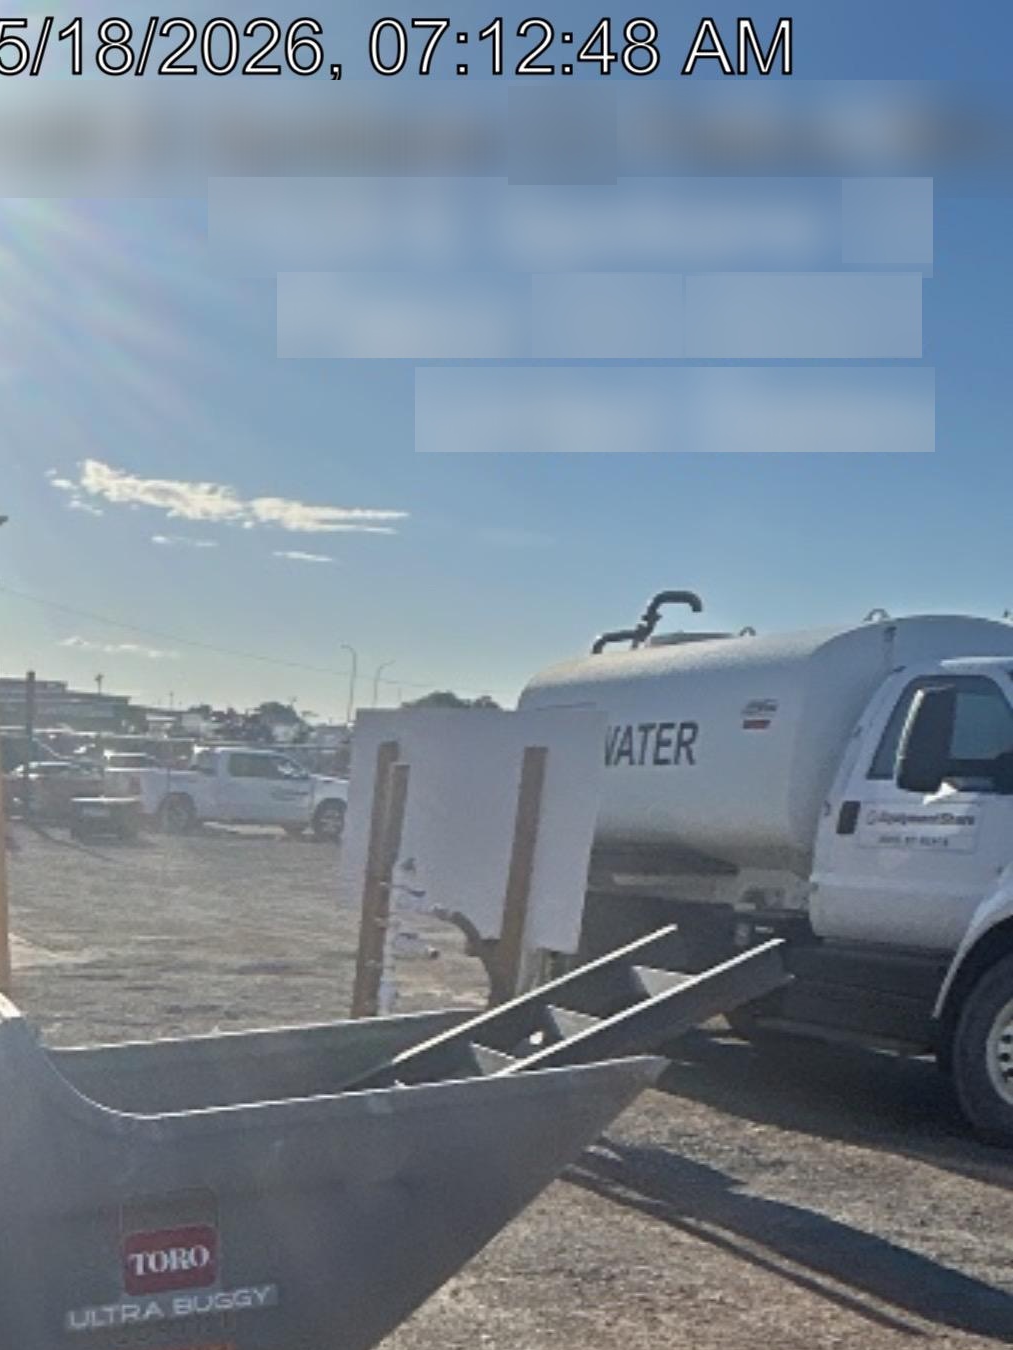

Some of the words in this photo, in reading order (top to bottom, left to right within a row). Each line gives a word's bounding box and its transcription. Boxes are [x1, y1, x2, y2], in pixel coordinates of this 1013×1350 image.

[128, 1244, 211, 1276] TORO
[68, 1301, 165, 1330] ULTRA
[172, 1285, 272, 1316] BUGGY
